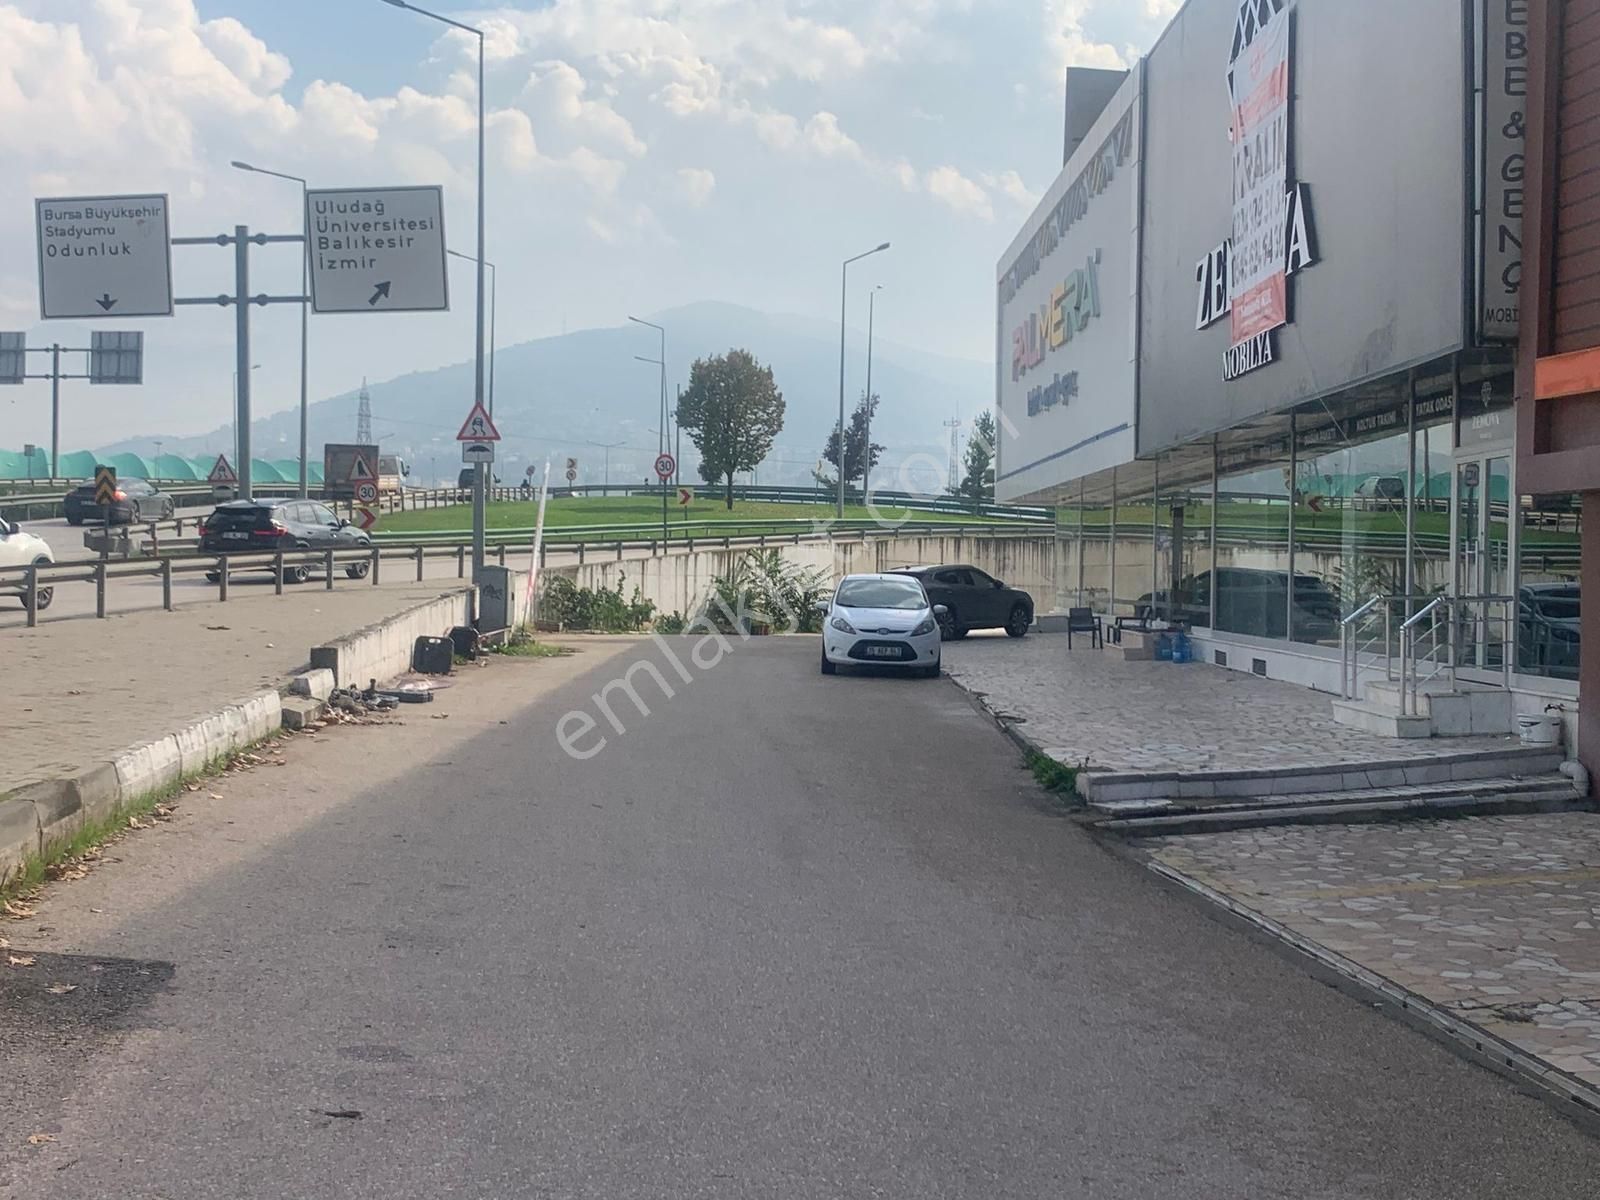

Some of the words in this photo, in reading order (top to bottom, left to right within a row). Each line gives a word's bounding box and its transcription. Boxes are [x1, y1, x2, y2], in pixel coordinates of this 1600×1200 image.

[1502, 111, 1525, 140] &
[44, 208, 82, 221] Bursa
[85, 206, 161, 221] Büyükşehir
[315, 199, 385, 216] Uludağ
[45, 225, 116, 239] Stadyumu
[316, 216, 434, 233] Üniversitesi
[46, 242, 131, 258] Odunluk
[318, 235, 414, 250] Balıkesir
[319, 252, 377, 270] İzmir
[1012, 255, 1101, 383] PALMERA
[1484, 306, 1519, 324] MOBİ
[1435, 395, 1454, 412] ODAS
[659, 460, 672, 472] 30
[361, 486, 375, 498] 30
